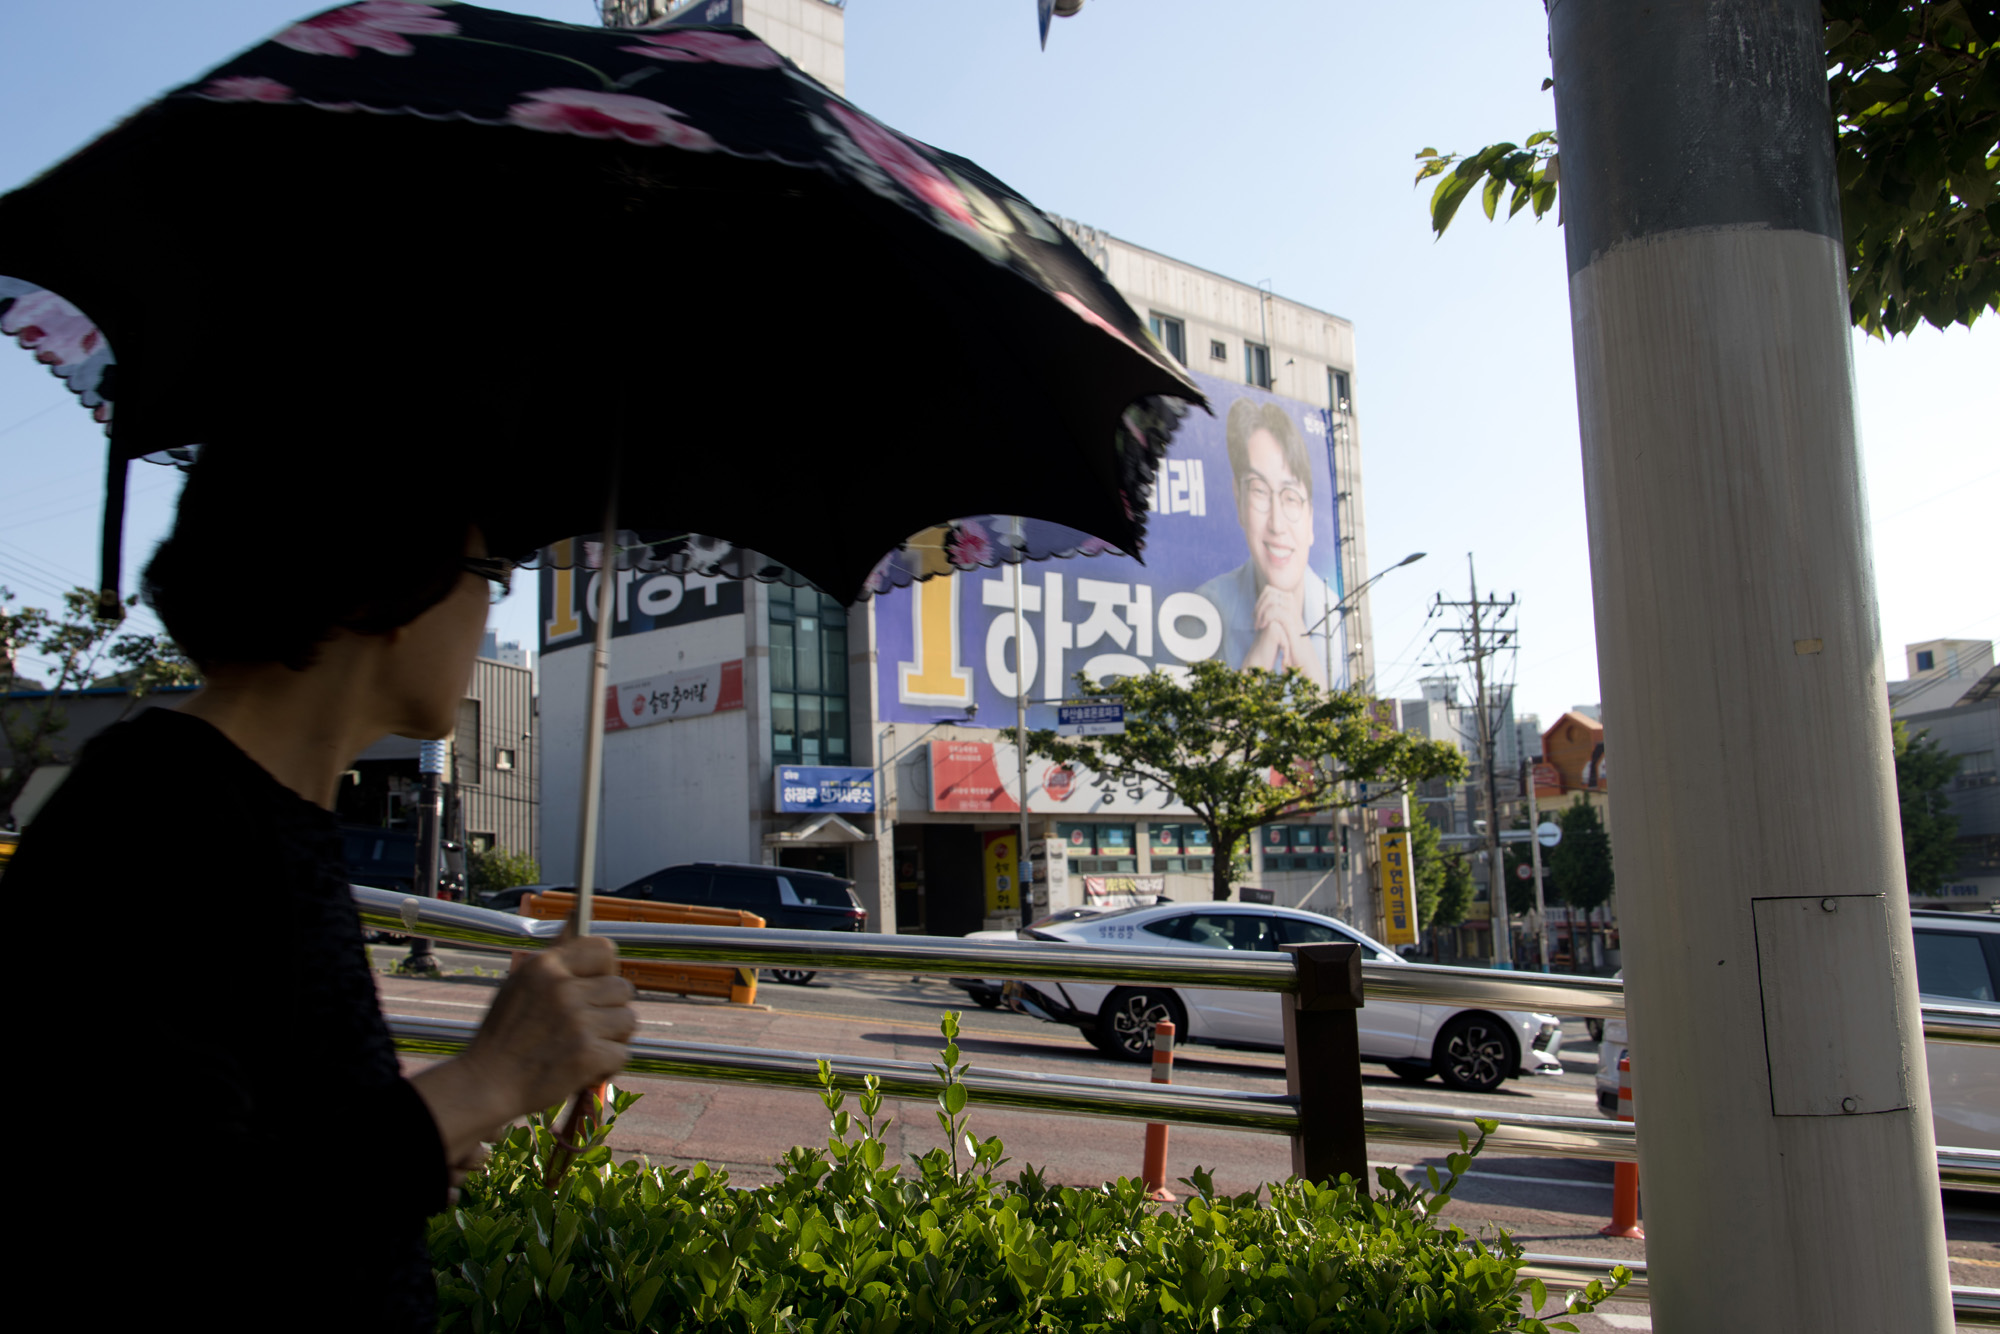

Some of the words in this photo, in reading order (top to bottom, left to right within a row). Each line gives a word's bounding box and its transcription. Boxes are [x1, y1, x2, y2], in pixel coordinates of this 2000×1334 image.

[898, 530, 974, 708] 1
[982, 564, 1223, 706] 하정우
[784, 786, 817, 803] 하정우
[820, 786, 872, 803] 선거사무소
